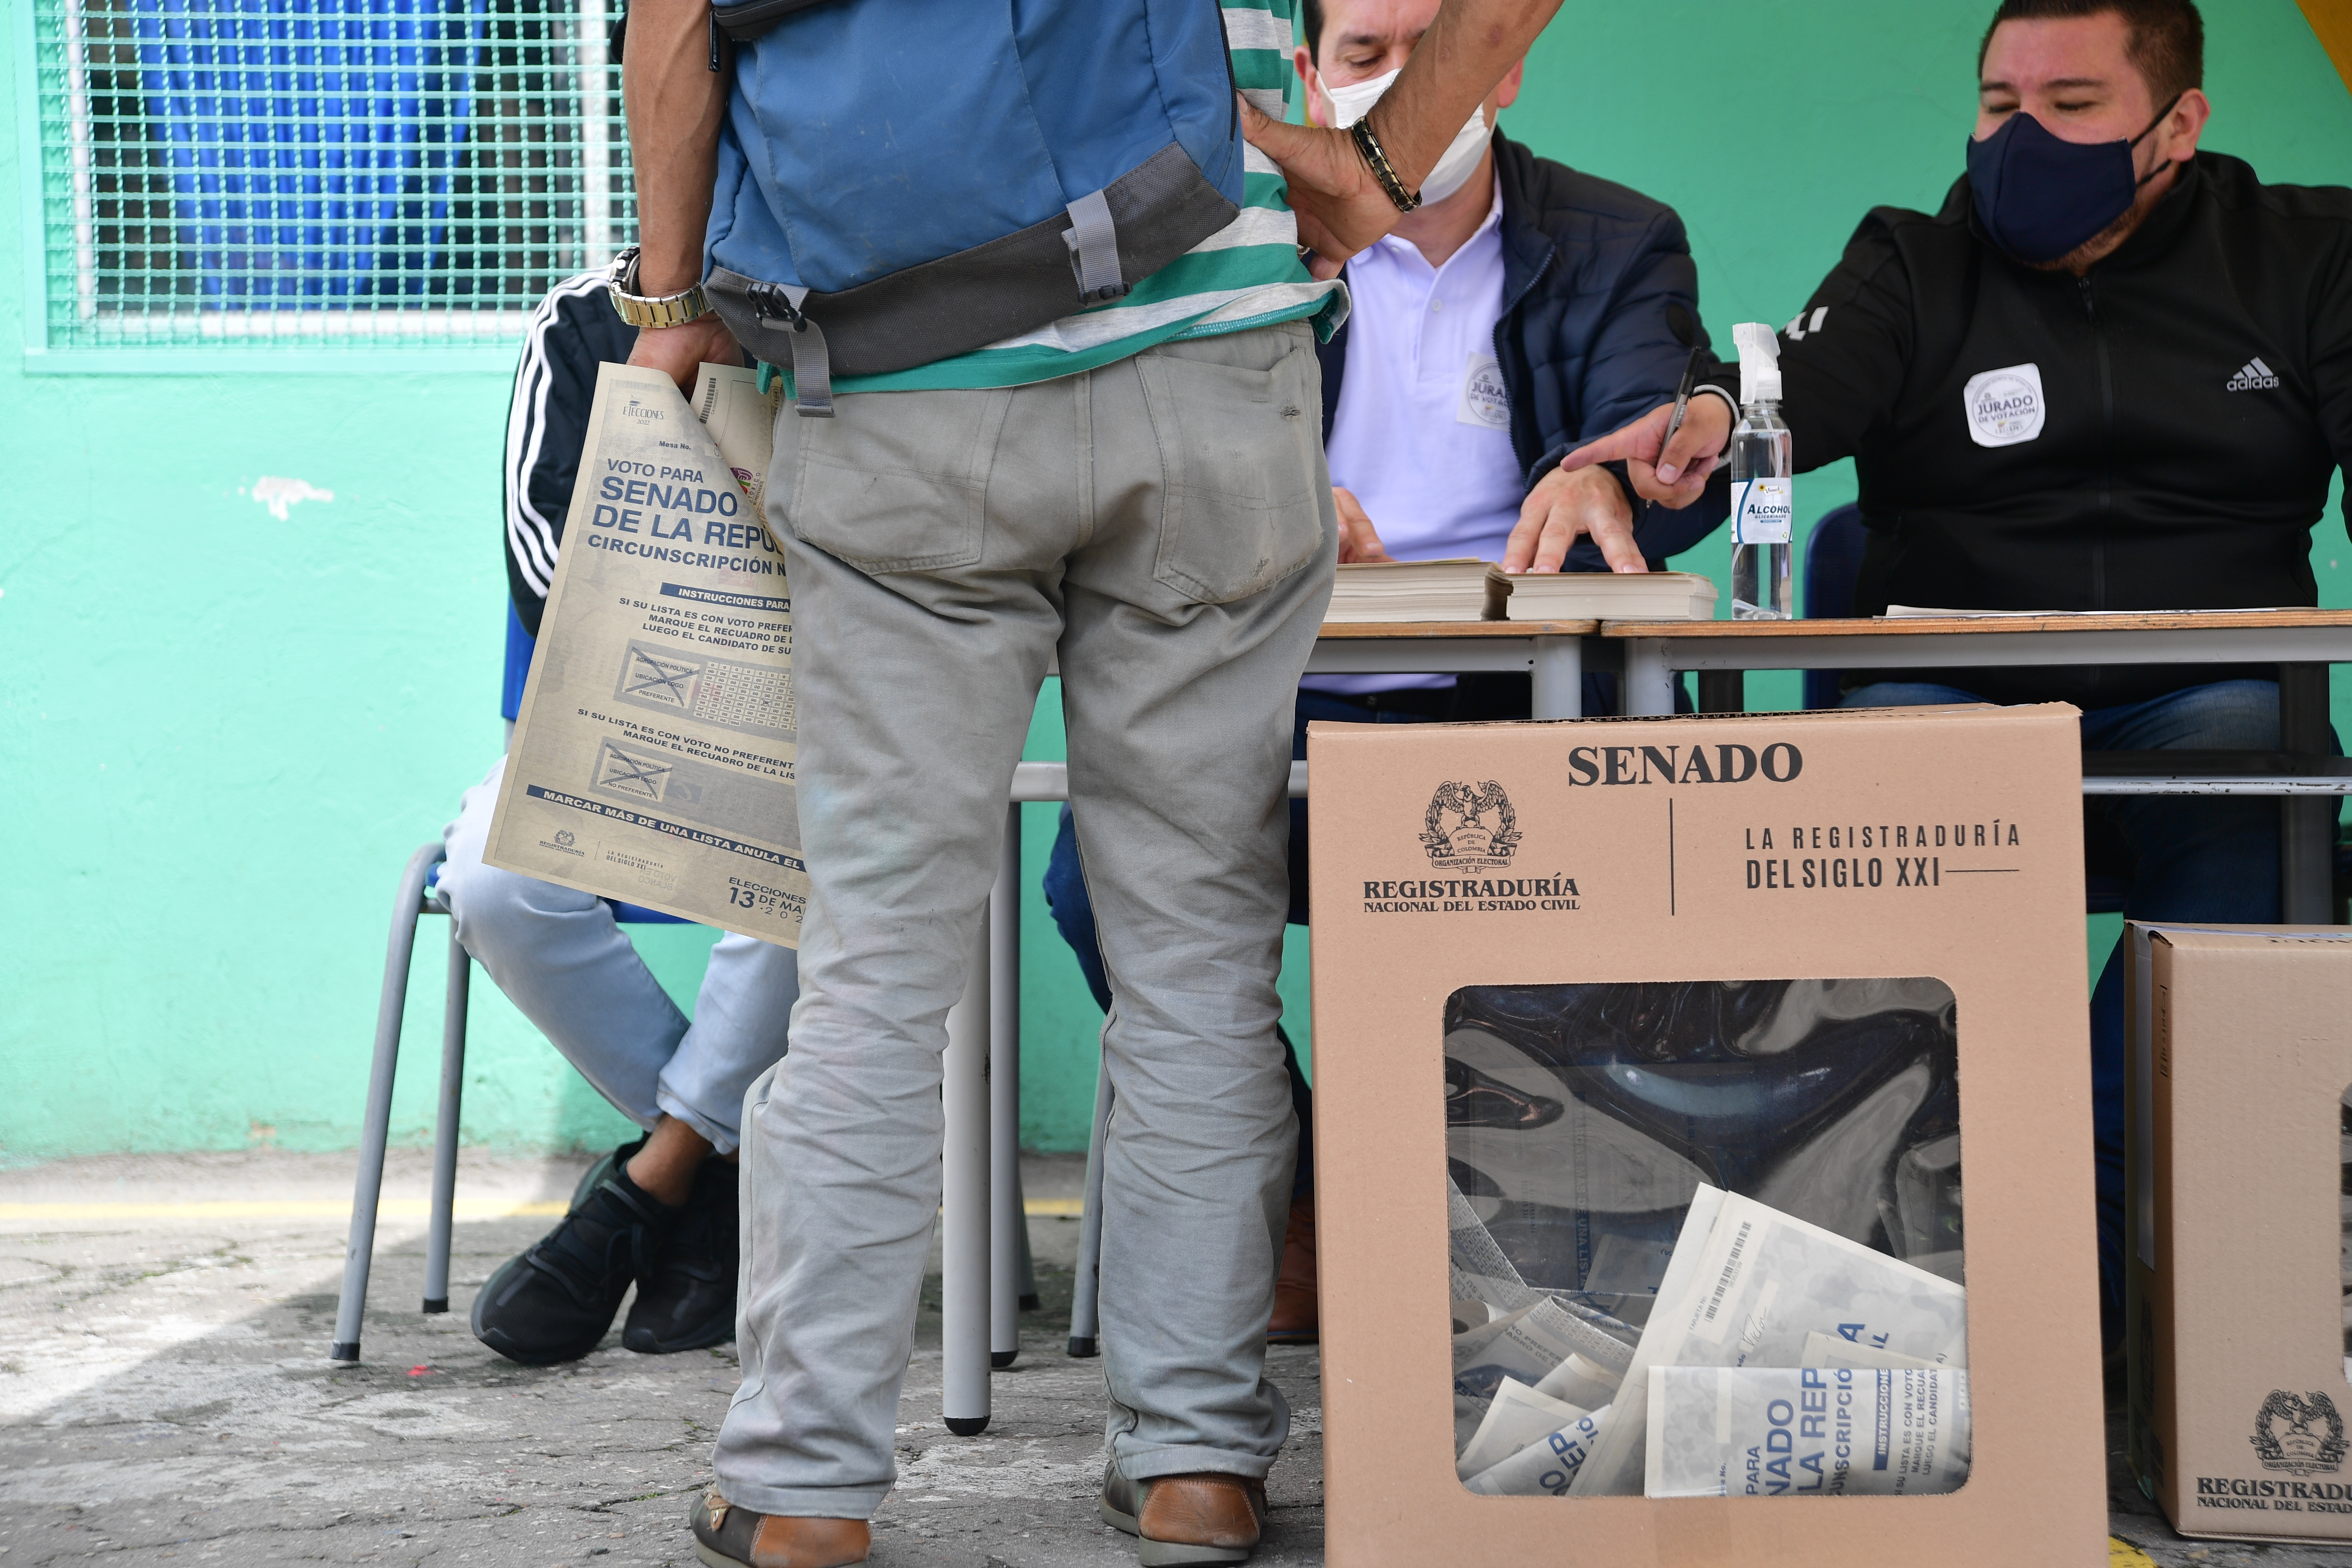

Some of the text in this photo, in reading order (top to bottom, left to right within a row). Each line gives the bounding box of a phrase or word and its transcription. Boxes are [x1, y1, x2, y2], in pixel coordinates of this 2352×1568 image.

[2226, 375, 2279, 392] adidas
[623, 406, 664, 420] ELECCIONES
[1978, 395, 2033, 415] JURADO
[1991, 406, 2035, 420] VOTACIÓN
[607, 458, 703, 483] VOTO PARA
[600, 476, 738, 516] SENADO
[1747, 504, 1790, 514] ALCOHOL
[592, 504, 642, 533] DE
[651, 514, 692, 542] LA
[588, 534, 772, 574] CIRCUNSCRIPCIÓN
[678, 588, 789, 610] INSTRUCCIONES PARA
[633, 600, 648, 609] SU
[651, 604, 681, 616] LISTA
[684, 611, 697, 619] ES
[701, 614, 724, 624] CON
[727, 618, 755, 628] VOTO
[642, 623, 791, 655] LUEGO EL CANDIDATO DE SU
[648, 614, 694, 629] MARQUE
[697, 624, 710, 632] EL
[714, 627, 770, 643] RECUADRO
[773, 635, 786, 643] DE
[636, 657, 692, 674] AGRUPACIÓN POLÍTICA
[635, 673, 666, 684] UBICACIÓN
[639, 690, 675, 703] PREFERENTE
[591, 712, 605, 721] SU
[608, 716, 637, 730] LISTA
[641, 725, 654, 734] ES
[658, 730, 680, 741] CON
[684, 737, 711, 749] VOTO
[714, 745, 729, 754] NO
[732, 750, 794, 768] PREFERENT
[610, 754, 664, 772] AGRUPACIÓN POLÍTICA
[623, 730, 668, 746] MARQUE
[687, 748, 743, 767] RECUADRO
[747, 762, 760, 771] DE
[763, 767, 776, 775] LA
[1568, 742, 1803, 787] SENADO
[618, 785, 653, 798] PREFERENTE
[544, 791, 800, 869] MARCAR MÁS DE UNA LISTA ANULA EL
[1457, 833, 1486, 841] REPÚBLICA
[1746, 819, 2020, 849] LA REGISTRADURÍA
[539, 841, 585, 855] REGISTRADURÍA
[618, 852, 663, 868] REGISTRADURÍA
[618, 858, 634, 866] SIGLO
[1435, 856, 1475, 866] ORGANIZACIÓN
[1802, 858, 1882, 888] SIGLO
[1896, 857, 1939, 887] XXI
[729, 877, 806, 904] ELECCIONES
[1364, 872, 1580, 899] REGISTRADURÍA
[730, 887, 806, 915] 13 DE MA
[1364, 899, 1581, 912] NACIONAL DEL ESTADO CIVIL
[1904, 1402, 1912, 1426] CON
[1916, 1414, 1925, 1427] EL
[1903, 1430, 1912, 1444] ES
[1928, 1428, 1936, 1441] EL
[2286, 1438, 2314, 1446] REPÚBLICA
[1899, 1447, 1911, 1473] LISTA
[1911, 1431, 1924, 1472] MARQUE
[1922, 1445, 1935, 1475] LUEGO
[1745, 1446, 1760, 1494] PARA
[1797, 1451, 1824, 1491] LA
[2265, 1459, 2336, 1470] ORGANIZACIÓN ELECTORAL
[1896, 1476, 1905, 1487] SU
[2197, 1497, 2269, 1510] NACIONAL
[2273, 1500, 2302, 1511] DEL
